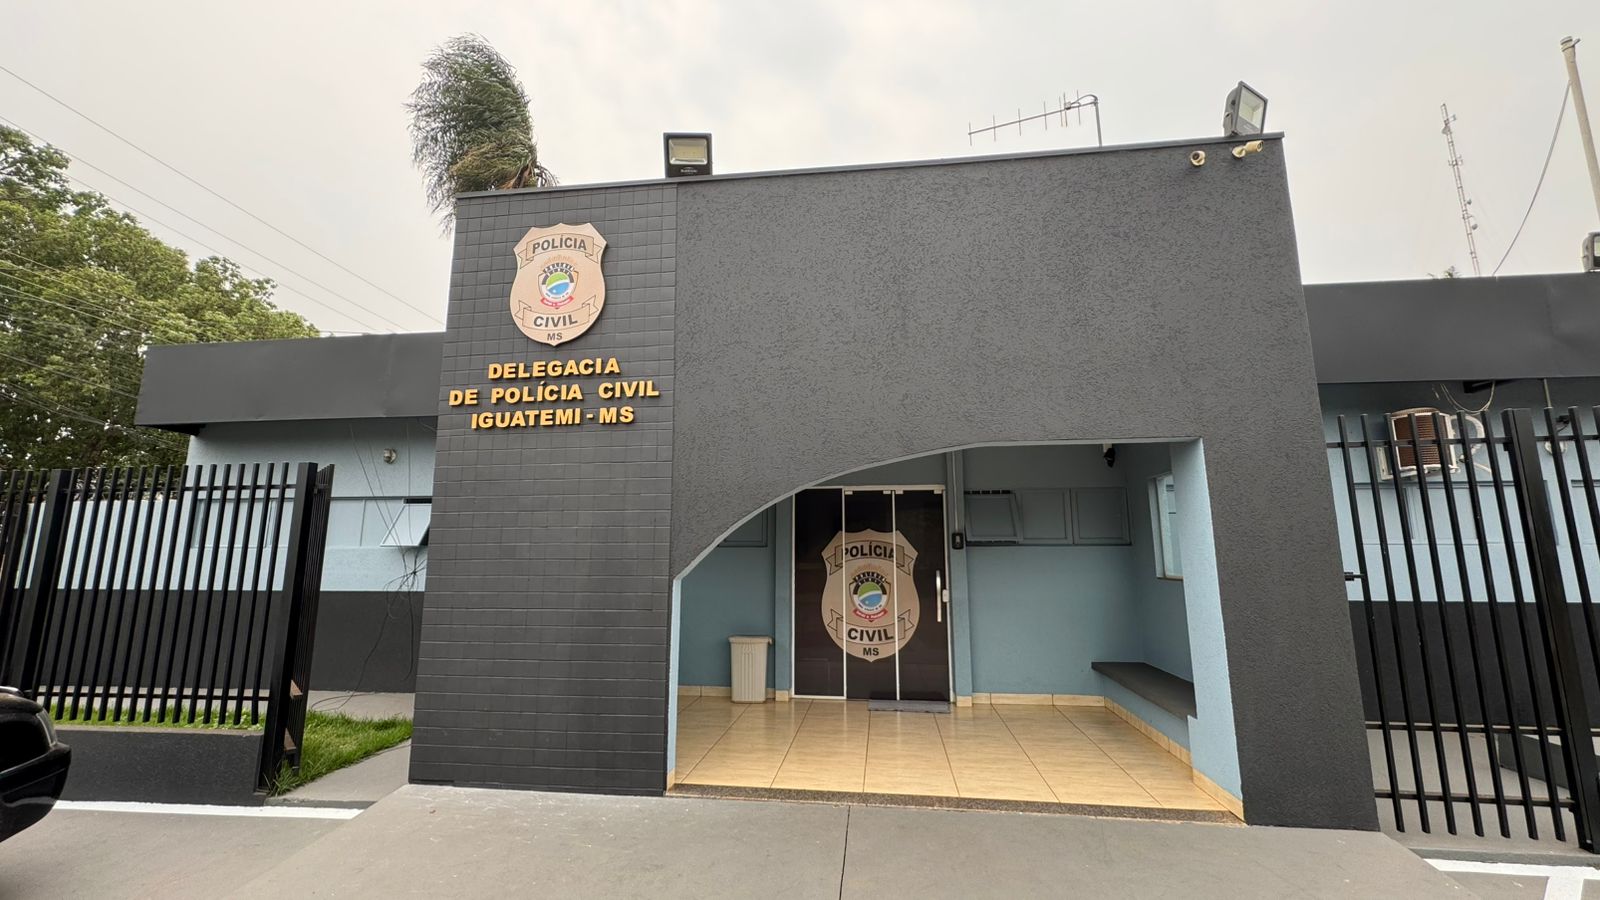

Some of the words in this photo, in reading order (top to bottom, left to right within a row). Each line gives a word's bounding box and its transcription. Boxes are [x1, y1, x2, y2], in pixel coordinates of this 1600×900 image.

[532, 234, 587, 254] POLÍCIA
[533, 313, 578, 328] CIVIL
[546, 332, 563, 341] MS
[488, 357, 621, 379] DELEGACIA
[449, 389, 479, 406] DE
[491, 380, 583, 404] POLÍCIA
[599, 380, 660, 399] CIVIL
[471, 408, 581, 429] IGUATEMI
[599, 406, 635, 424] MS
[847, 628, 894, 642] CIVIL
[862, 647, 880, 656] MS
